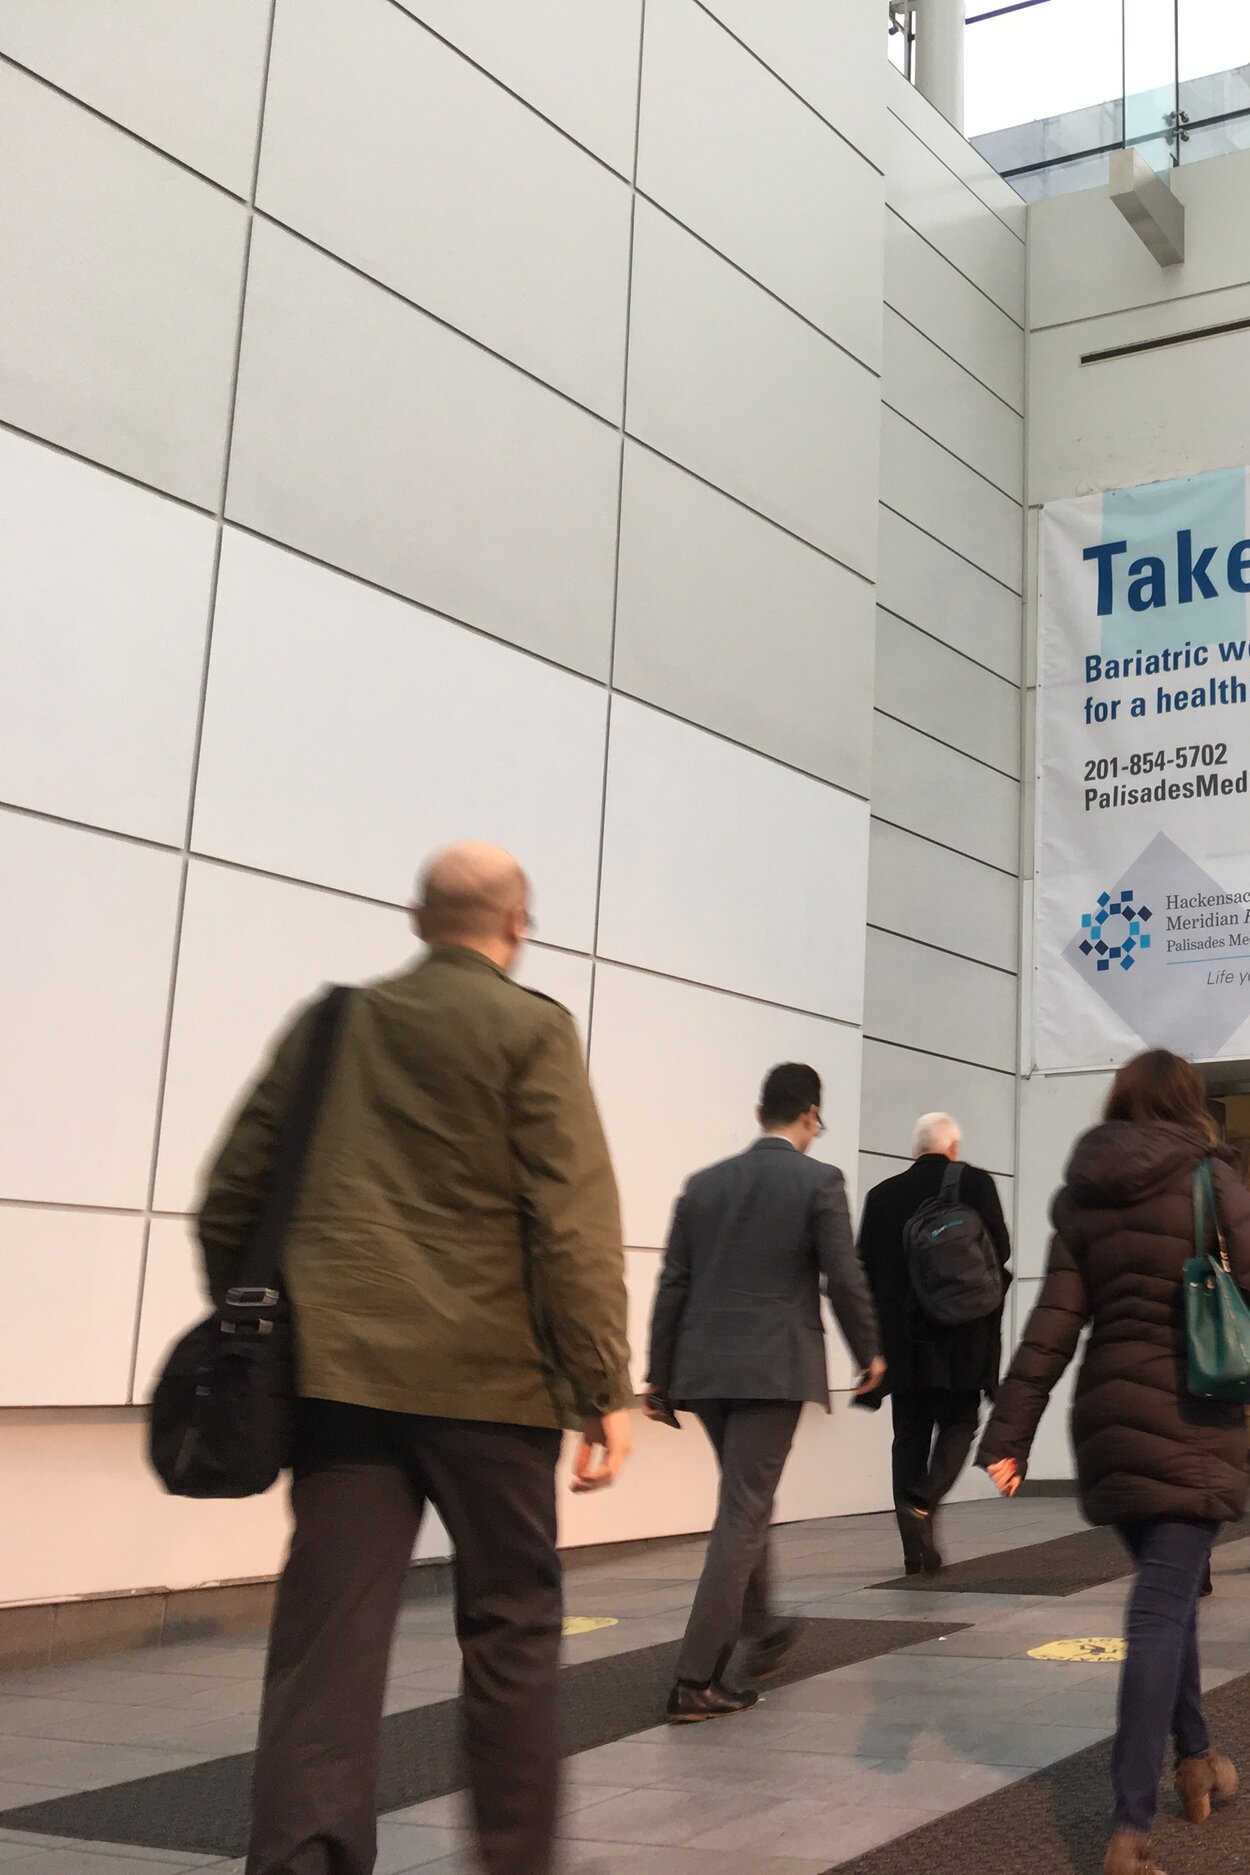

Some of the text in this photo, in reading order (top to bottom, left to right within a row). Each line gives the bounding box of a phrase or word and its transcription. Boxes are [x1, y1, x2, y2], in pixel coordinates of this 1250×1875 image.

[1084, 640, 1210, 684] Bariatric
[1083, 694, 1121, 725] for
[1129, 695, 1146, 718] a
[1083, 742, 1228, 784] 201-854-5702
[1165, 913, 1240, 932] Meridian
[1166, 936, 1226, 953] Palisades
[1206, 969, 1235, 986] Life
